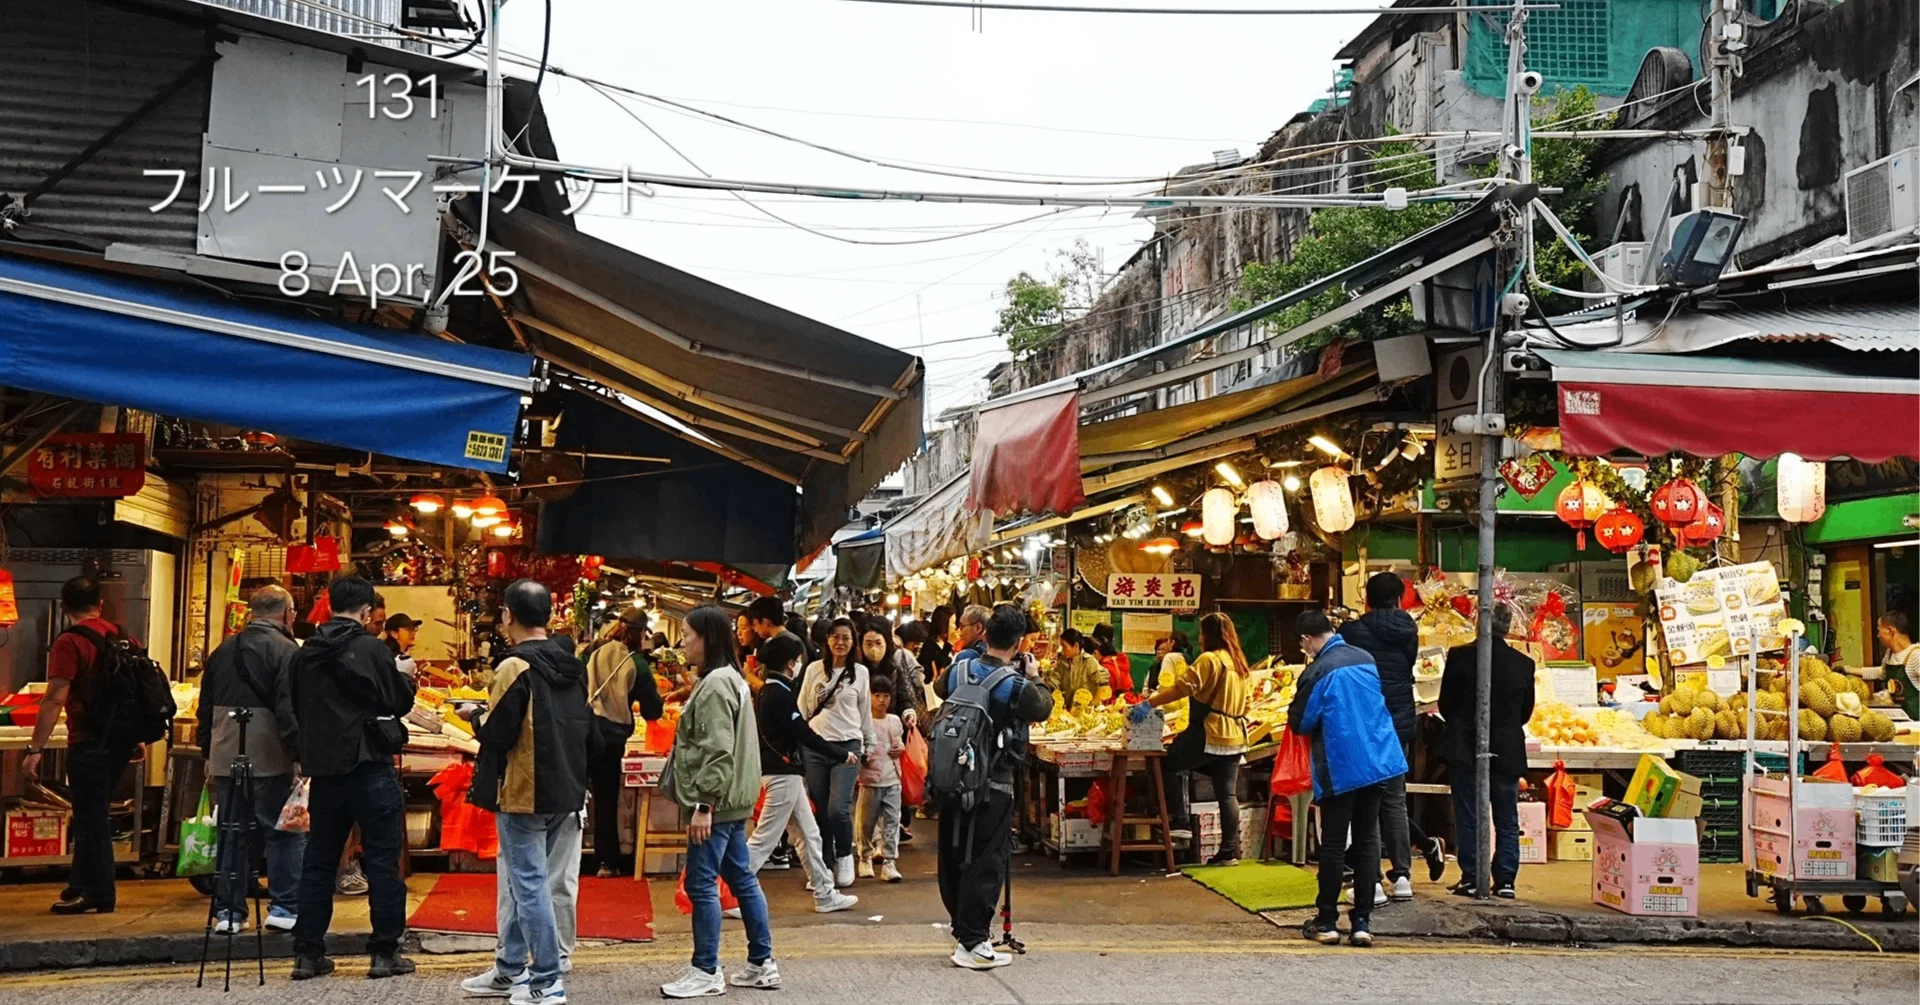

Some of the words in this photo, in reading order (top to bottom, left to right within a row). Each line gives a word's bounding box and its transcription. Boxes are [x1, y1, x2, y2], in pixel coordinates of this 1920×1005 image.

[1444, 442, 1472, 472] 全日
[1111, 599, 1126, 607] YAU
[1129, 599, 1143, 607] YIM
[1146, 599, 1160, 607] KEE
[1163, 599, 1185, 607] FRUIT
